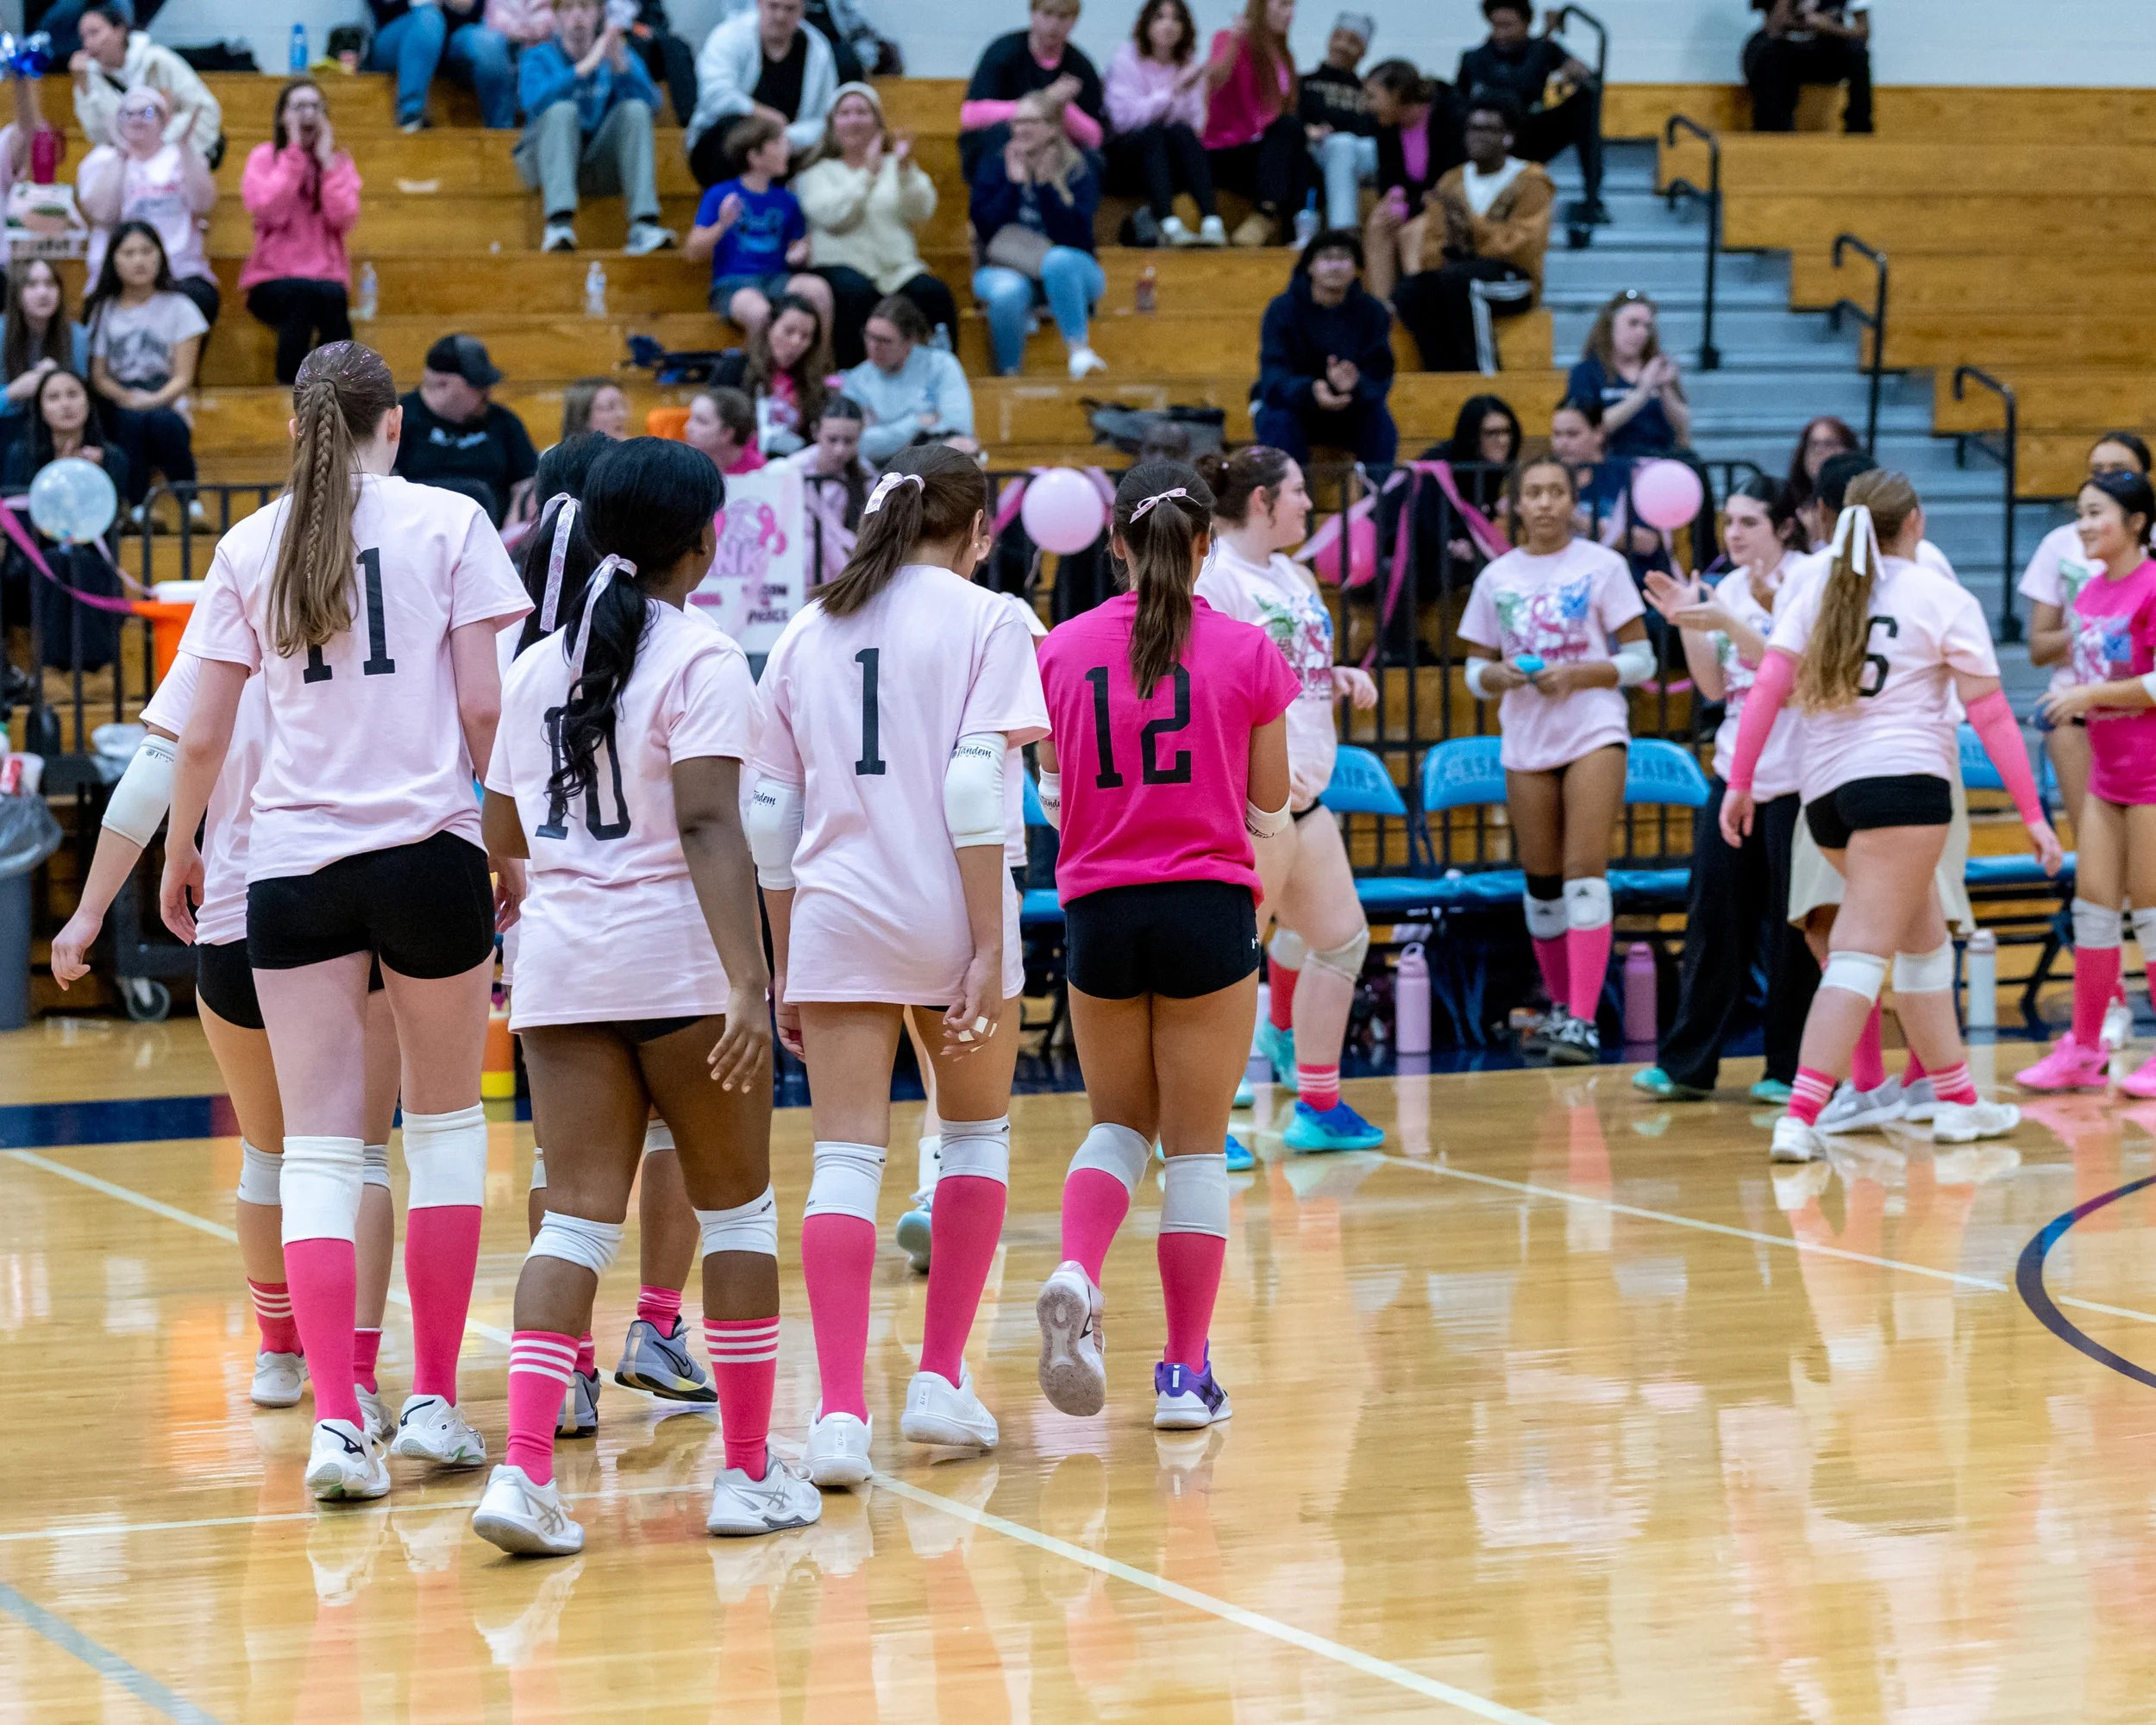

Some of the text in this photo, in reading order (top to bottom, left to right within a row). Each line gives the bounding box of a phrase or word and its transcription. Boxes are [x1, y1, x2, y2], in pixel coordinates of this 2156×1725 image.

[304, 547, 396, 684] 1
[1858, 616, 1898, 697] 6
[535, 704, 631, 841] 10
[855, 648, 886, 775] 1
[1085, 662, 1191, 788] 12
